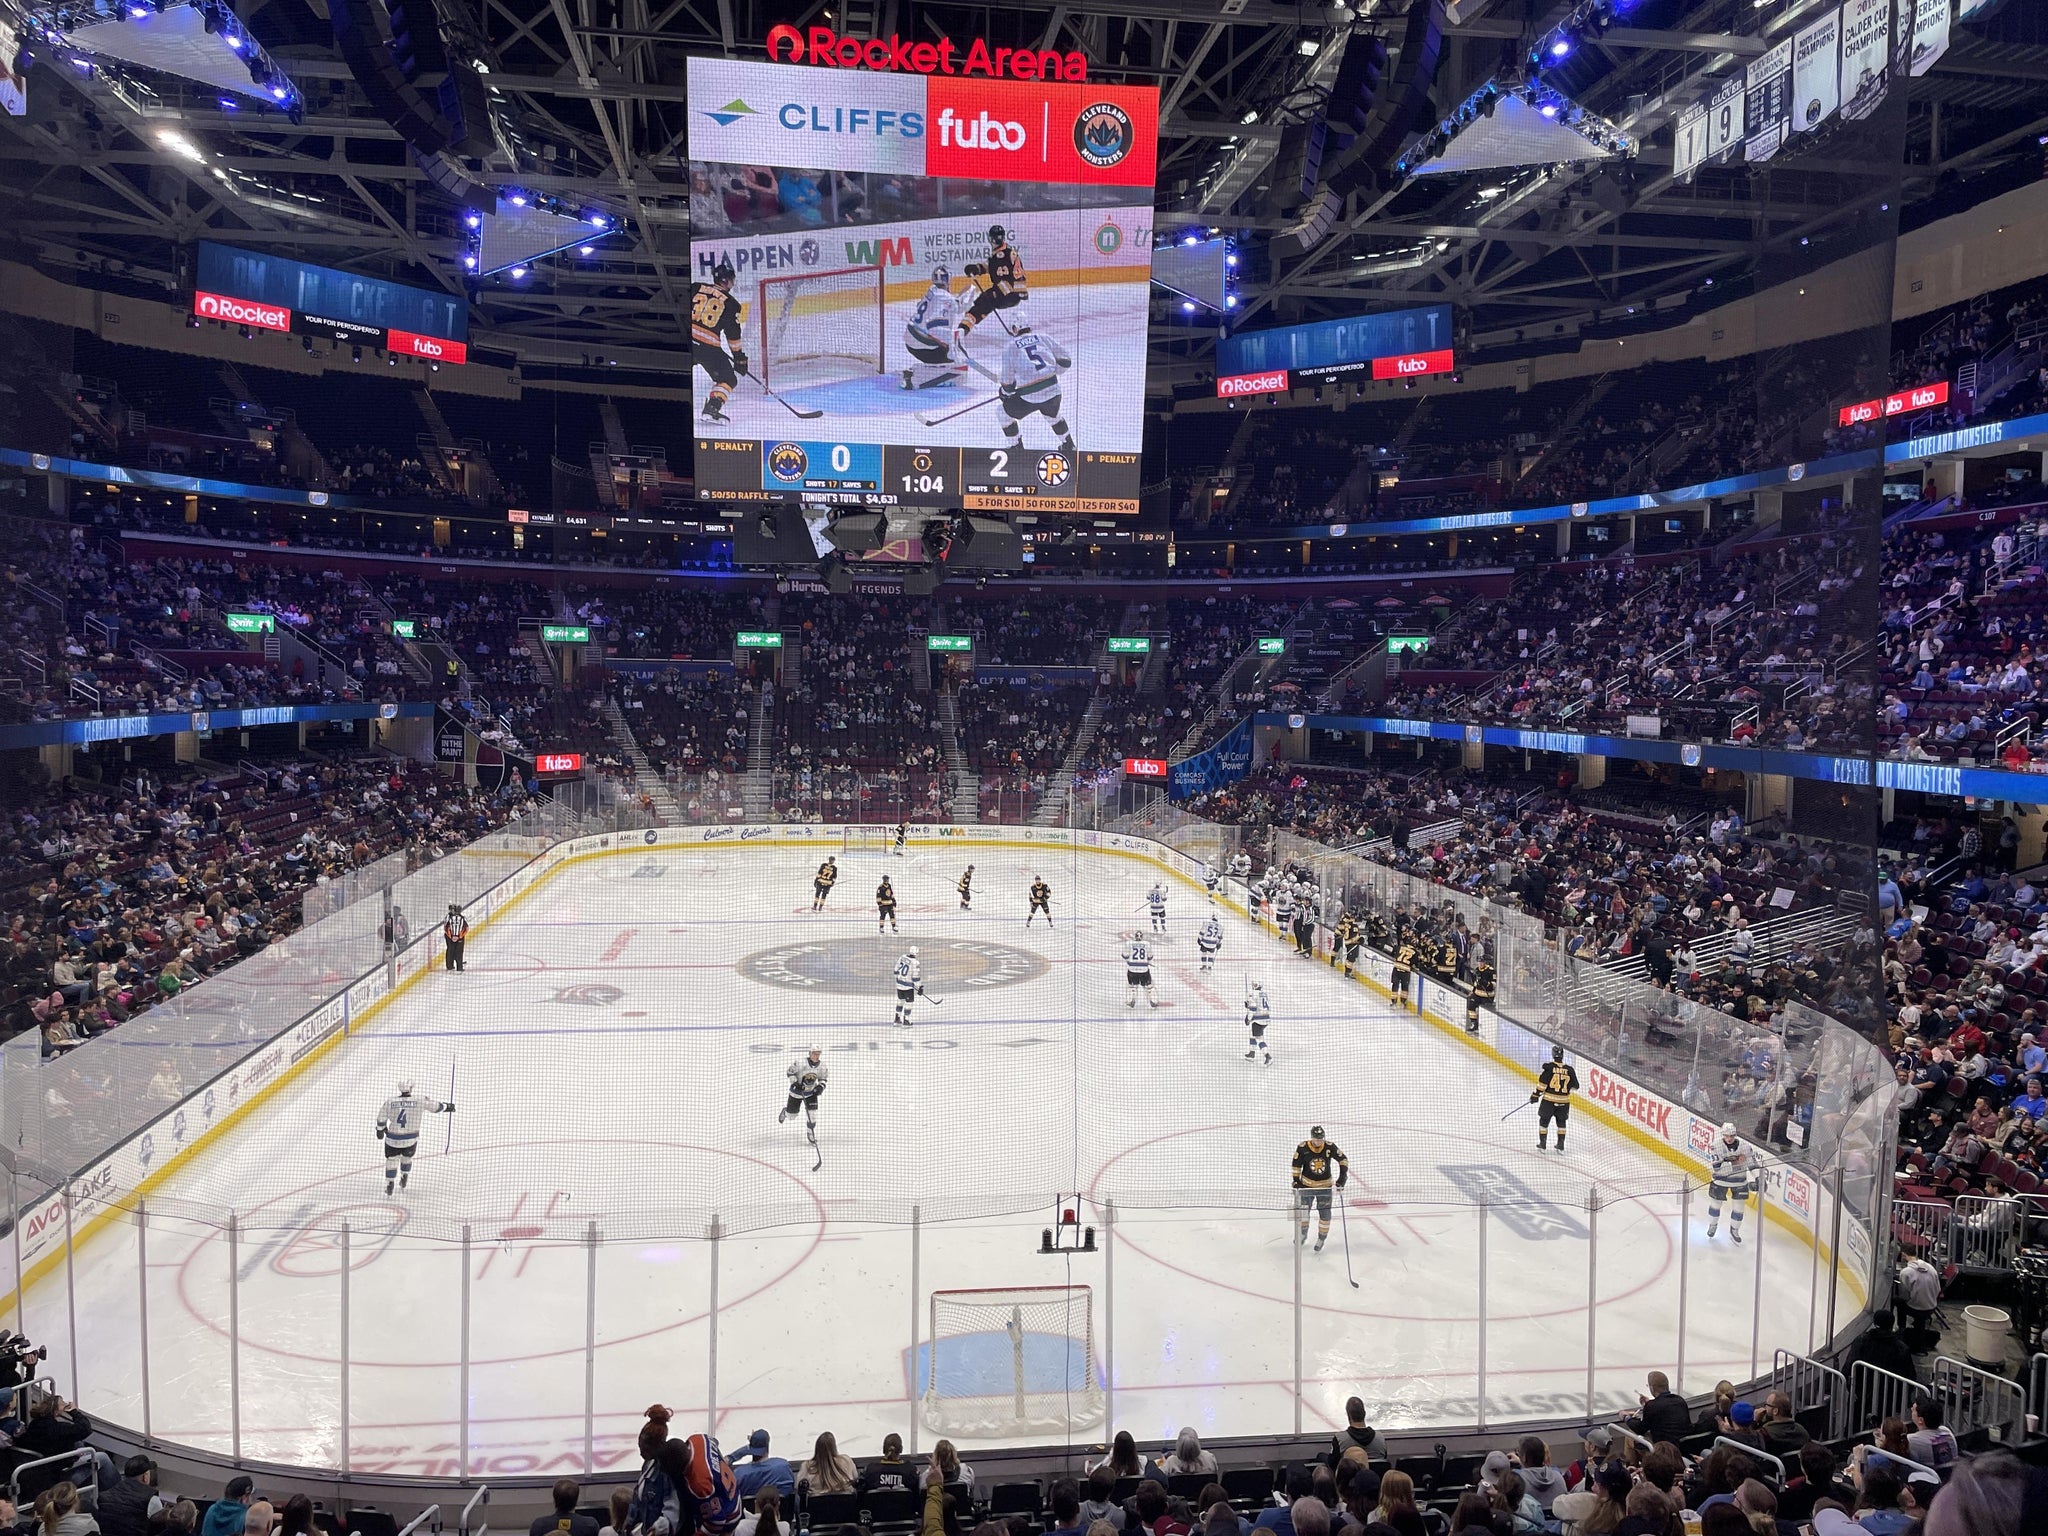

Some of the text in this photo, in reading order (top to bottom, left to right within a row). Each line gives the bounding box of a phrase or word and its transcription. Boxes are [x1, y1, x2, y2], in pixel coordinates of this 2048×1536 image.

[1845, 15, 1872, 42] CALDER
[1797, 30, 1835, 61] CHAMPIONS
[1845, 23, 1888, 58] CHAMPIONS
[810, 32, 1087, 81] Rocket Arena
[779, 103, 924, 138] CLIFFS
[1081, 105, 1128, 124] CLEVELAND
[938, 107, 1026, 151] fubo
[1720, 105, 1731, 143] 9
[1687, 126, 1693, 164] 1
[1080, 148, 1124, 166] MONSTERS
[924, 233, 962, 248] WE'RE
[845, 236, 915, 266] WM
[699, 243, 794, 276] HAPPEN
[219, 300, 286, 328] Rocket
[304, 316, 322, 325] YOUR
[323, 319, 336, 327] FOR
[336, 332, 348, 340] CAP
[413, 338, 443, 356] fubo
[1025, 345, 1046, 371] 5
[1398, 358, 1428, 374] fubo
[1234, 374, 1285, 393] Rocket
[1912, 390, 1936, 406] fubo
[1850, 405, 1872, 421] fubo
[714, 443, 753, 451] PENALTY
[1909, 422, 2003, 459] CLEVELAND MONSTERS
[774, 444, 804, 457] CLEVELAND
[831, 445, 851, 473] 0
[920, 460, 926, 468] 1
[989, 450, 1009, 478] 2
[1099, 455, 1137, 464] PENALTY
[805, 480, 826, 488] SHOTS
[868, 482, 875, 490] 4
[902, 474, 944, 493] 1:04
[968, 485, 988, 493] SHOTS
[994, 485, 1000, 494] 6
[1026, 486, 1036, 495] 17
[711, 491, 736, 499] 50/50
[738, 491, 769, 500] RAFFLE
[801, 492, 898, 505] TONIGHT'S TOTAL $4,631
[977, 498, 1136, 511] 5 FOR $10 50 FOR $20 125 FOR $40
[1440, 508, 1512, 529] CLEVELAND MONSTERS
[705, 524, 726, 532] SHOTS
[1036, 533, 1048, 542] 17
[1139, 533, 1153, 541] 7:00
[230, 618, 254, 628] Sprite
[546, 629, 568, 639] Sprite
[739, 635, 761, 644] Sprite
[930, 638, 951, 647] Sprite
[1111, 640, 1131, 649] Sprite
[450, 740, 463, 748] THE
[441, 748, 463, 757] PAINT
[1216, 752, 1229, 761] Full
[545, 756, 573, 770] fubo
[1133, 760, 1159, 774] fubo
[1222, 761, 1244, 770] Power
[1897, 763, 1961, 795] MONSTERS
[703, 826, 735, 841] Culver's
[741, 826, 773, 840] Culver's
[939, 827, 966, 837] WM
[1124, 839, 1149, 852] CLIFFS
[822, 870, 833, 880] 27
[1132, 949, 1146, 960] 28
[302, 1010, 329, 1043] CENTER
[1549, 1073, 1571, 1093] 47
[1588, 1068, 1671, 1140] SEATGEEK
[397, 1109, 407, 1128] 4
[1692, 1121, 1710, 1141] drug
[1692, 1137, 1713, 1152] mart
[73, 1165, 112, 1207] LAKE
[1788, 1175, 1807, 1198] drug
[1788, 1191, 1809, 1211] mart
